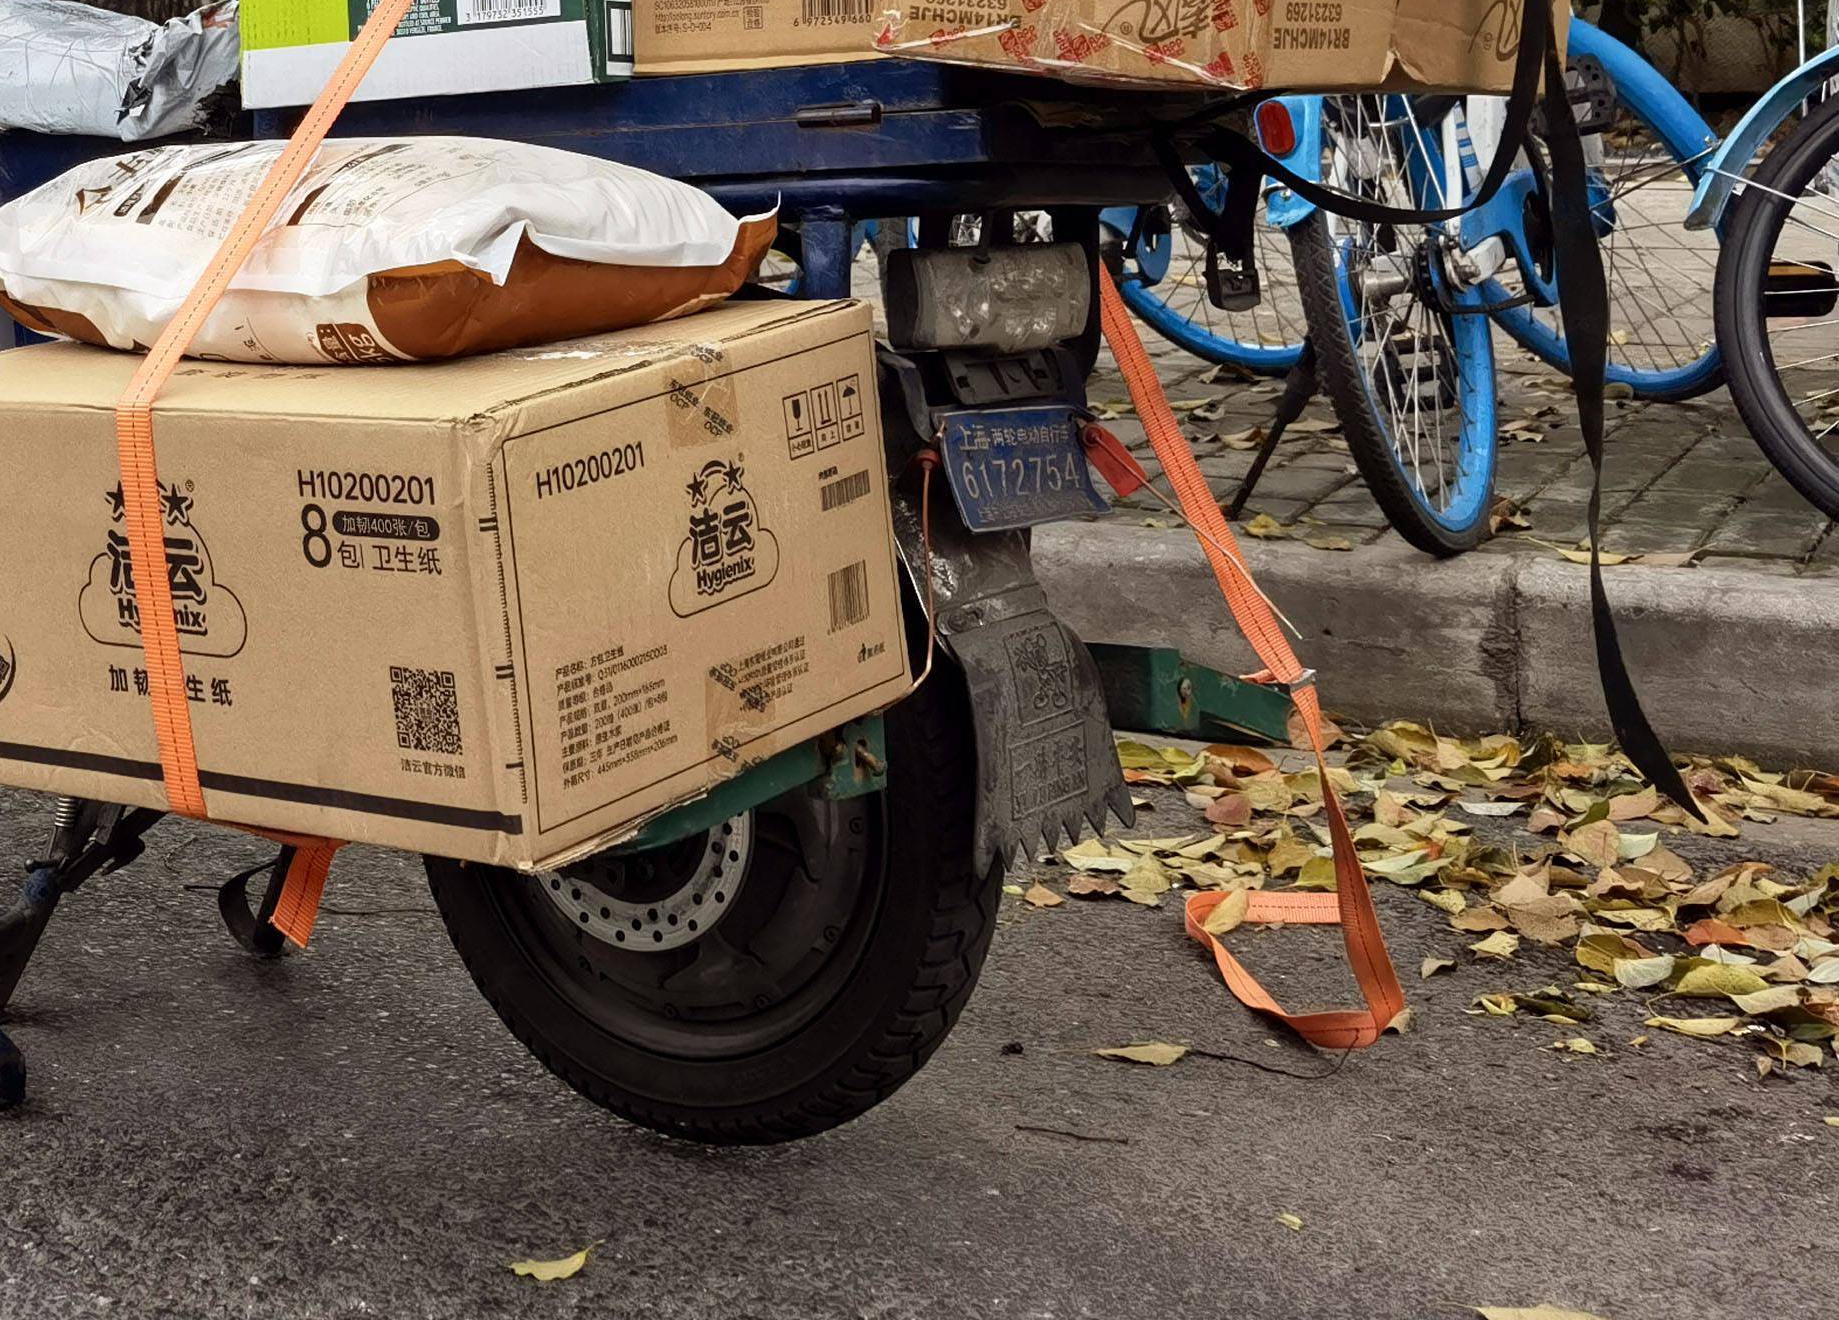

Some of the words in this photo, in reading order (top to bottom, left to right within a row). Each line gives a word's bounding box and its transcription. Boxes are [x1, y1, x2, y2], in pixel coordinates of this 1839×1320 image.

[466, 13, 470, 21] 3
[477, 7, 507, 21] 179732
[512, 7, 544, 17] 351555
[794, 18, 799, 27] 6
[909, 5, 1022, 30] BR14MCHJE
[1286, 2, 1342, 22] 63231269
[1273, 28, 1350, 49] BR14MCHJE
[959, 424, 991, 451] 上海
[535, 440, 646, 500] H10200201
[962, 452, 1080, 499] 6172754
[297, 470, 436, 506] H10200201
[301, 503, 332, 569] 8
[342, 514, 431, 540] 加韧400张/包
[689, 499, 757, 567] 洁云
[371, 545, 443, 576] 卫生纸
[695, 555, 757, 595] Hygienix
[400, 757, 466, 780] 洁云官方微信
